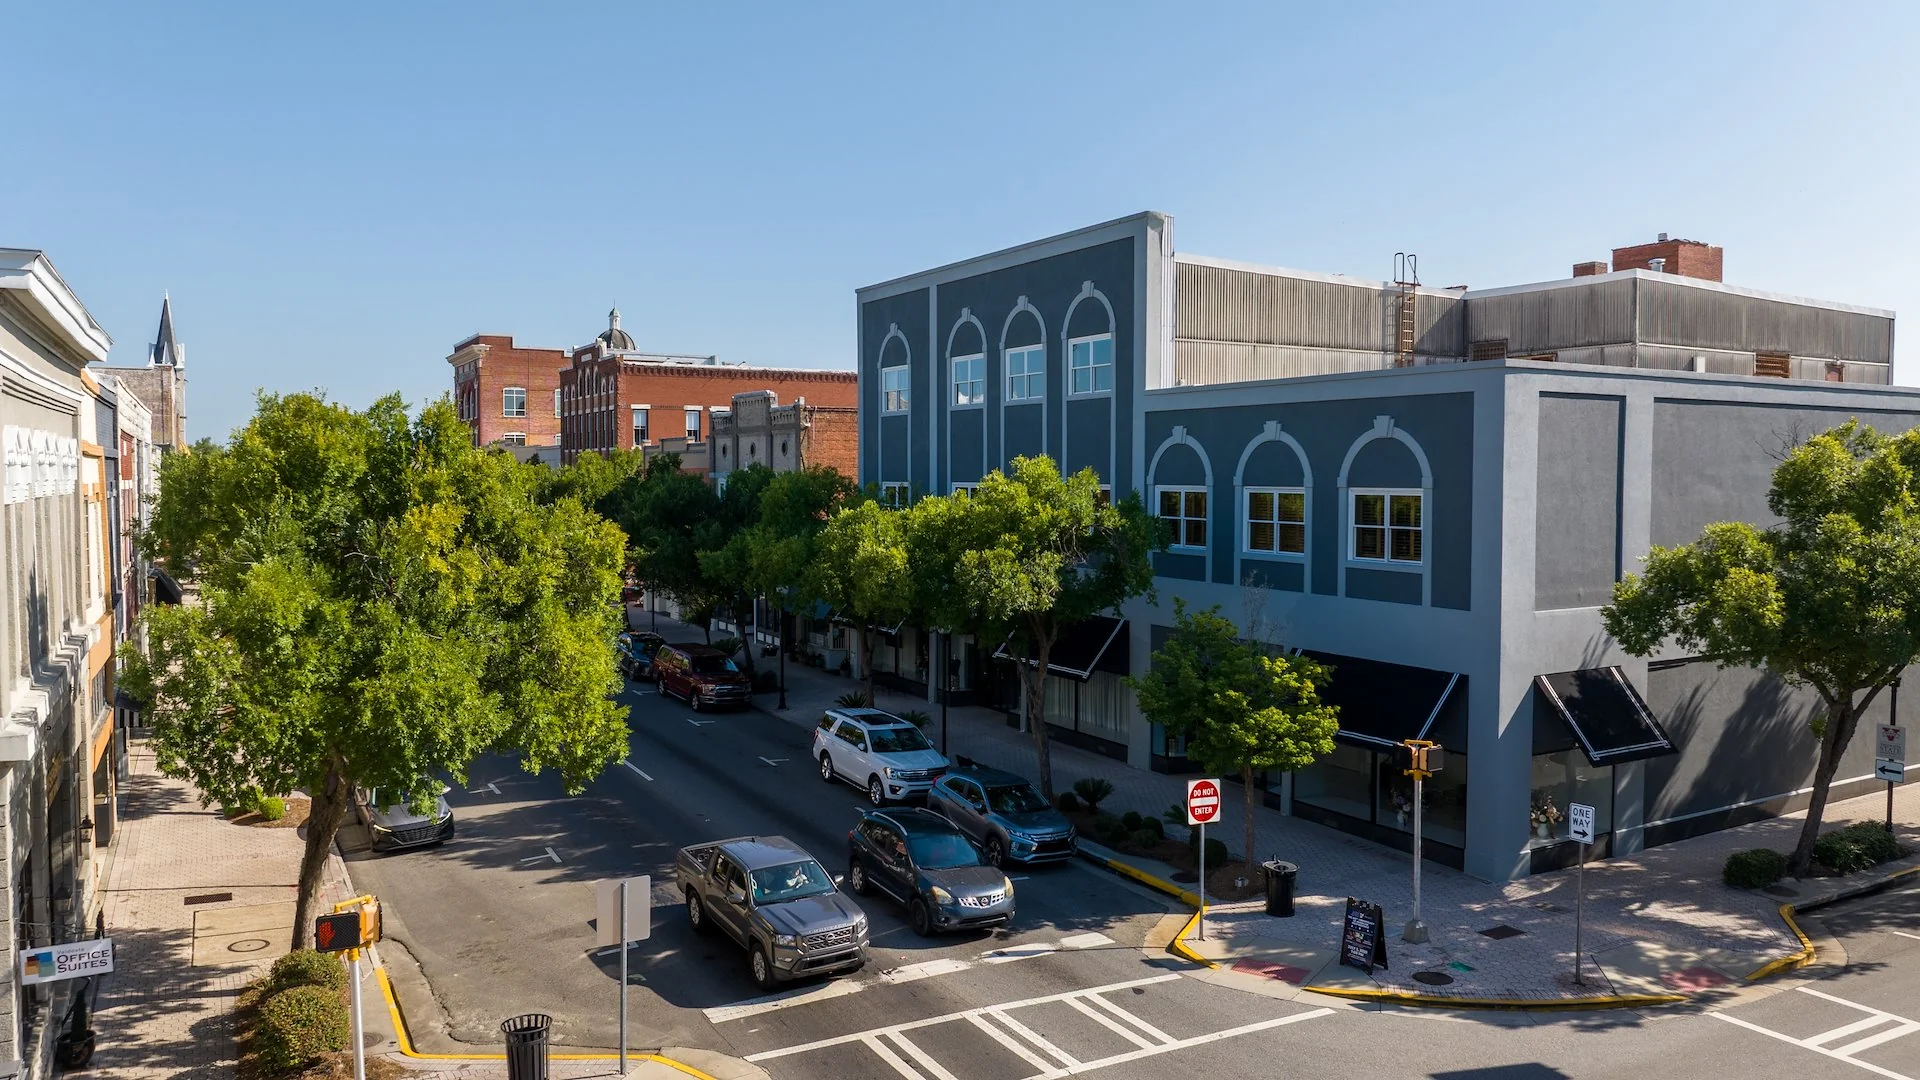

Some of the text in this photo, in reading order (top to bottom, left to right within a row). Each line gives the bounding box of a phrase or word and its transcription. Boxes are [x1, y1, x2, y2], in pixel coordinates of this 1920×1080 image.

[1193, 788, 1214, 797] DO NOT
[1194, 806, 1213, 815] ENTER
[1572, 807, 1591, 819] ONE
[1572, 817, 1591, 828] WAY
[56, 949, 110, 964] OFFICE
[57, 959, 108, 974] SUITES
